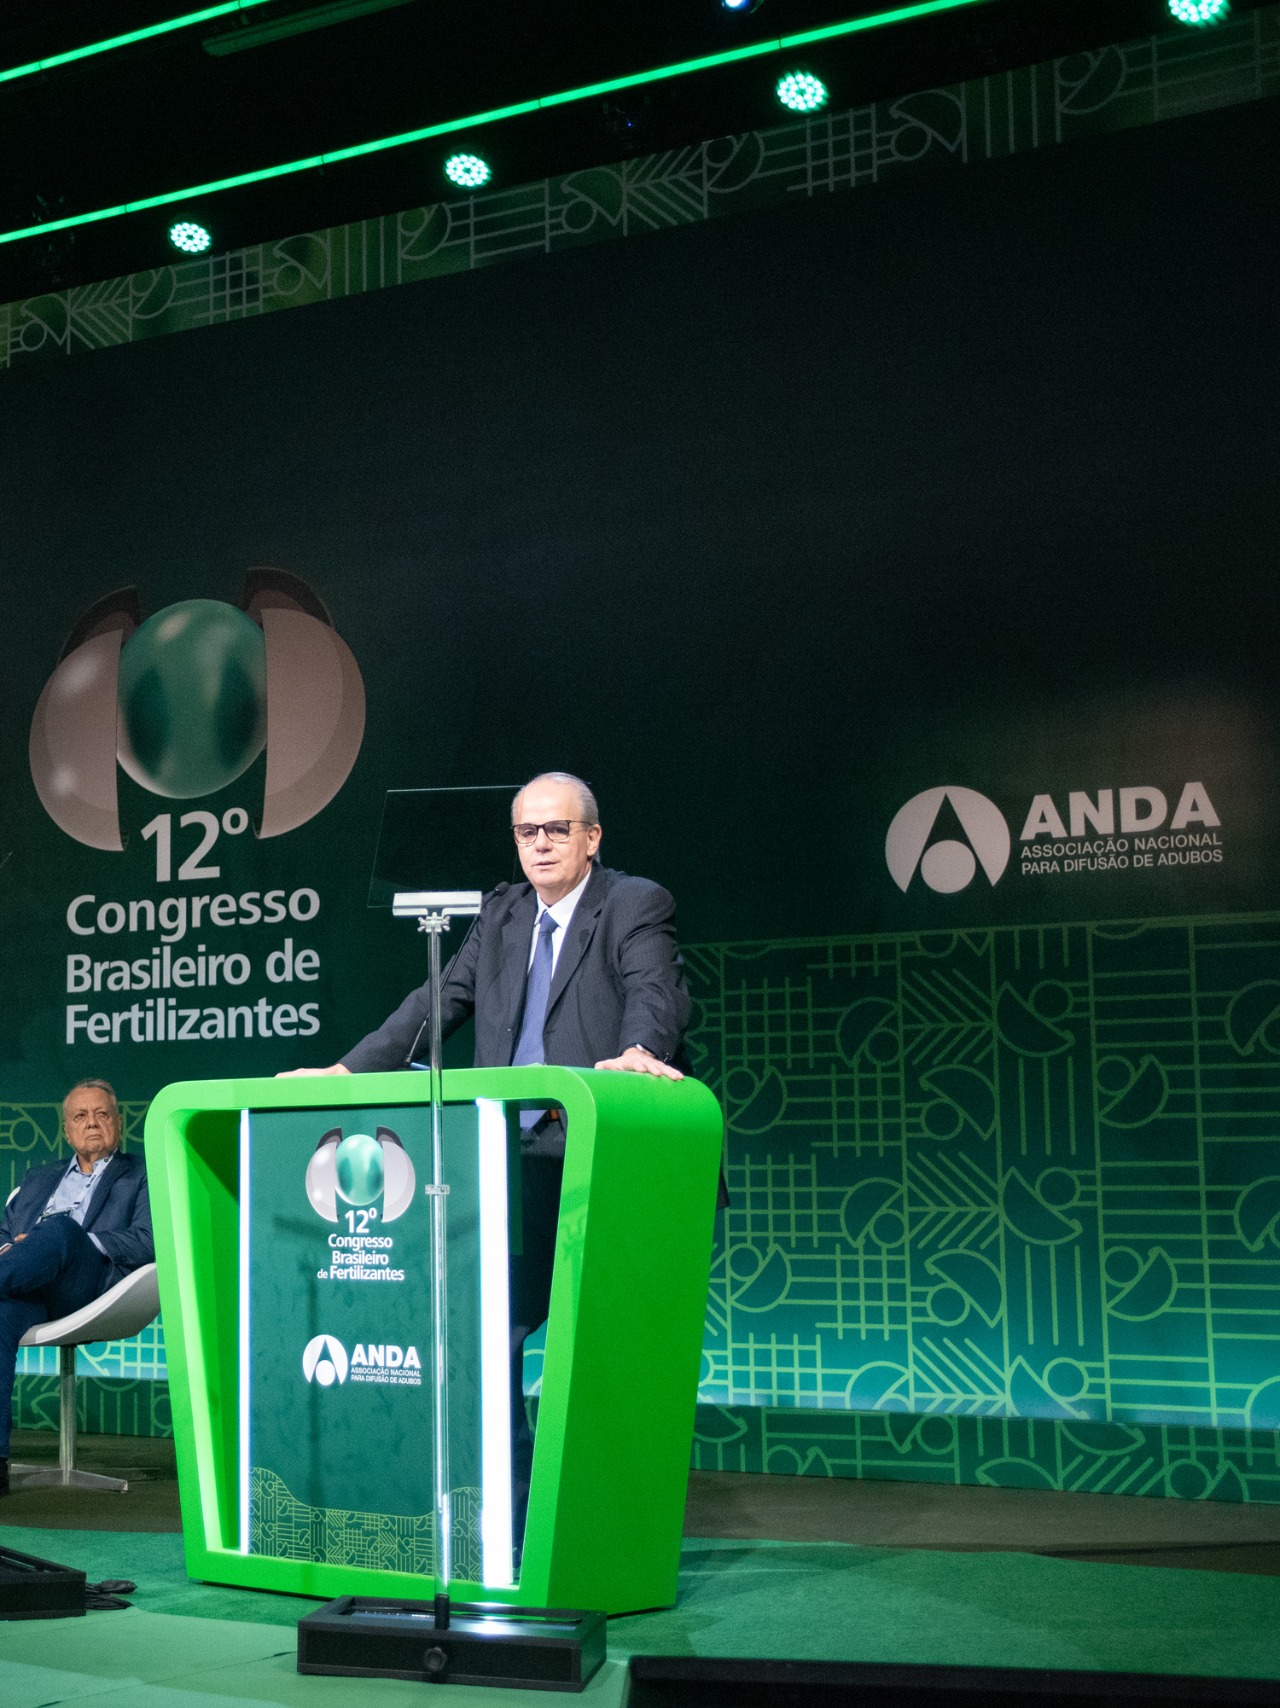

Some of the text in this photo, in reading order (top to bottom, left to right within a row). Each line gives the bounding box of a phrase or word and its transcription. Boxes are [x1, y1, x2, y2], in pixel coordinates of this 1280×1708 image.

[1019, 781, 1221, 841] ANDA
[1021, 833, 1223, 858] ASSOCIAÇÃO NACIONAL
[1022, 850, 1223, 875] PARA DIFUSÃO DE ADUBOS
[66, 887, 320, 943] Congresso
[66, 938, 320, 993] Brasileiro de
[66, 997, 320, 1044] Fertilizantes
[327, 1233, 393, 1251] Congresso
[332, 1249, 389, 1265] Brasileiro
[317, 1265, 405, 1280] de Fertilizantes
[350, 1343, 422, 1369] ANDA
[350, 1366, 422, 1377] ASSOCIAÇÃO NACIONAL
[350, 1374, 365, 1382] PARA
[389, 1376, 398, 1384] DE
[397, 1377, 422, 1385] ADUBOS
